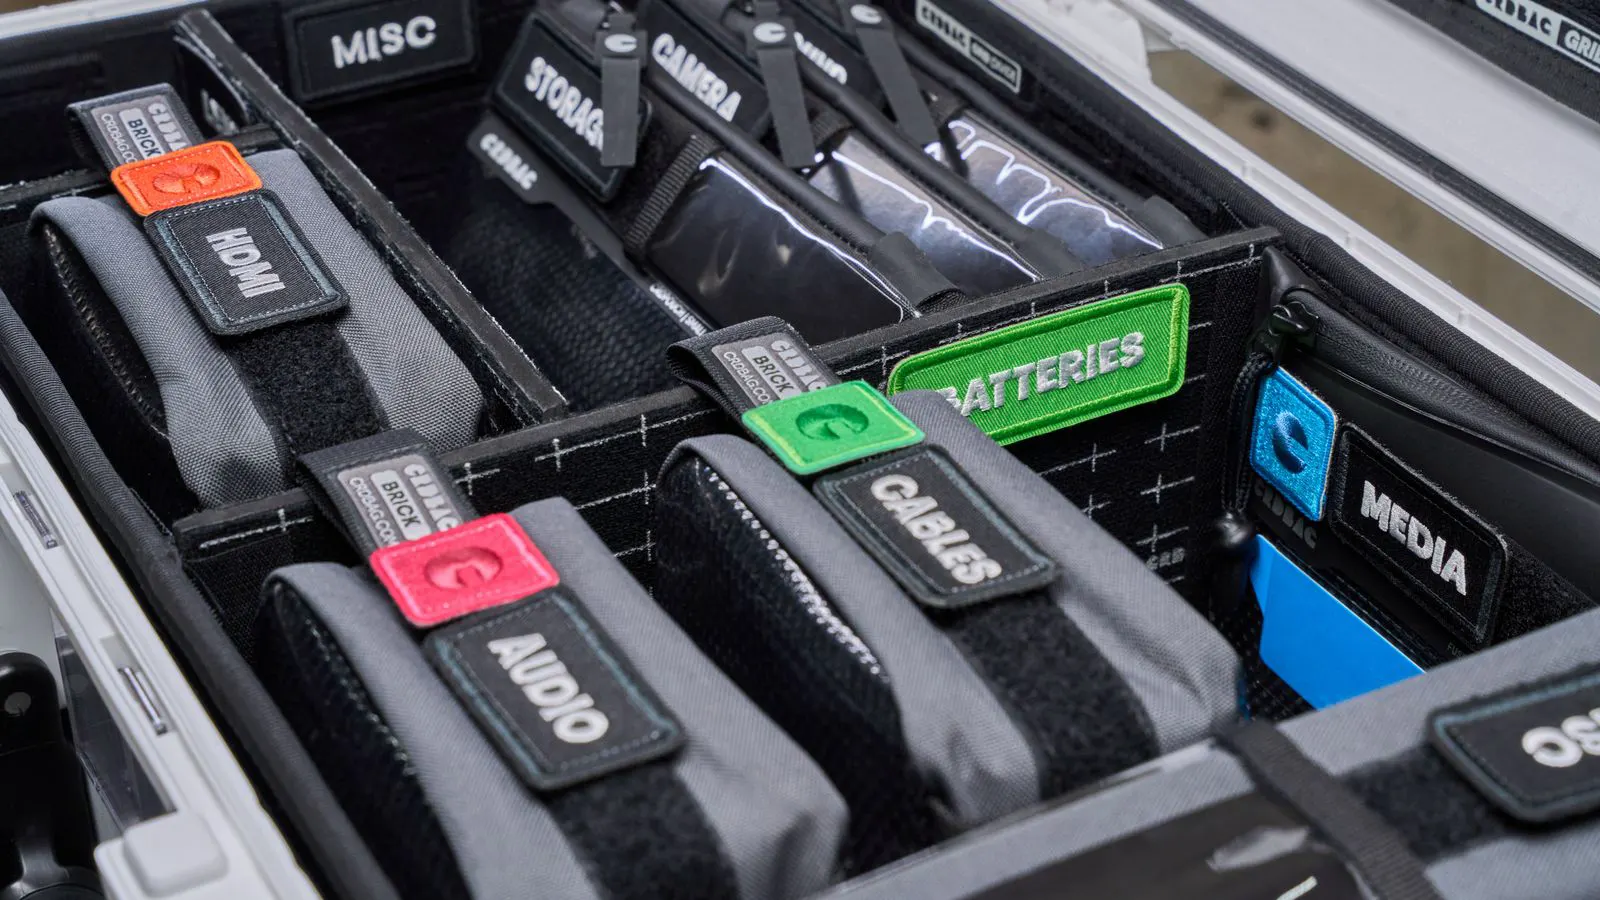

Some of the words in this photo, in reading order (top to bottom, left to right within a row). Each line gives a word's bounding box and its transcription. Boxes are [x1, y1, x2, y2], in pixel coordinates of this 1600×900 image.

[330, 15, 437, 69] MISC
[652, 33, 741, 122] CAMERA
[127, 118, 163, 157] BRICK
[525, 56, 604, 151] STORAG
[205, 227, 286, 298] HDMI
[723, 351, 772, 405] CRDBAG.CO
[752, 355, 795, 393] BRICK
[381, 481, 422, 528] BRICK
[870, 473, 1002, 585] CABLES
[1360, 479, 1467, 596] MEDIA
[486, 632, 610, 744] AUDIO
